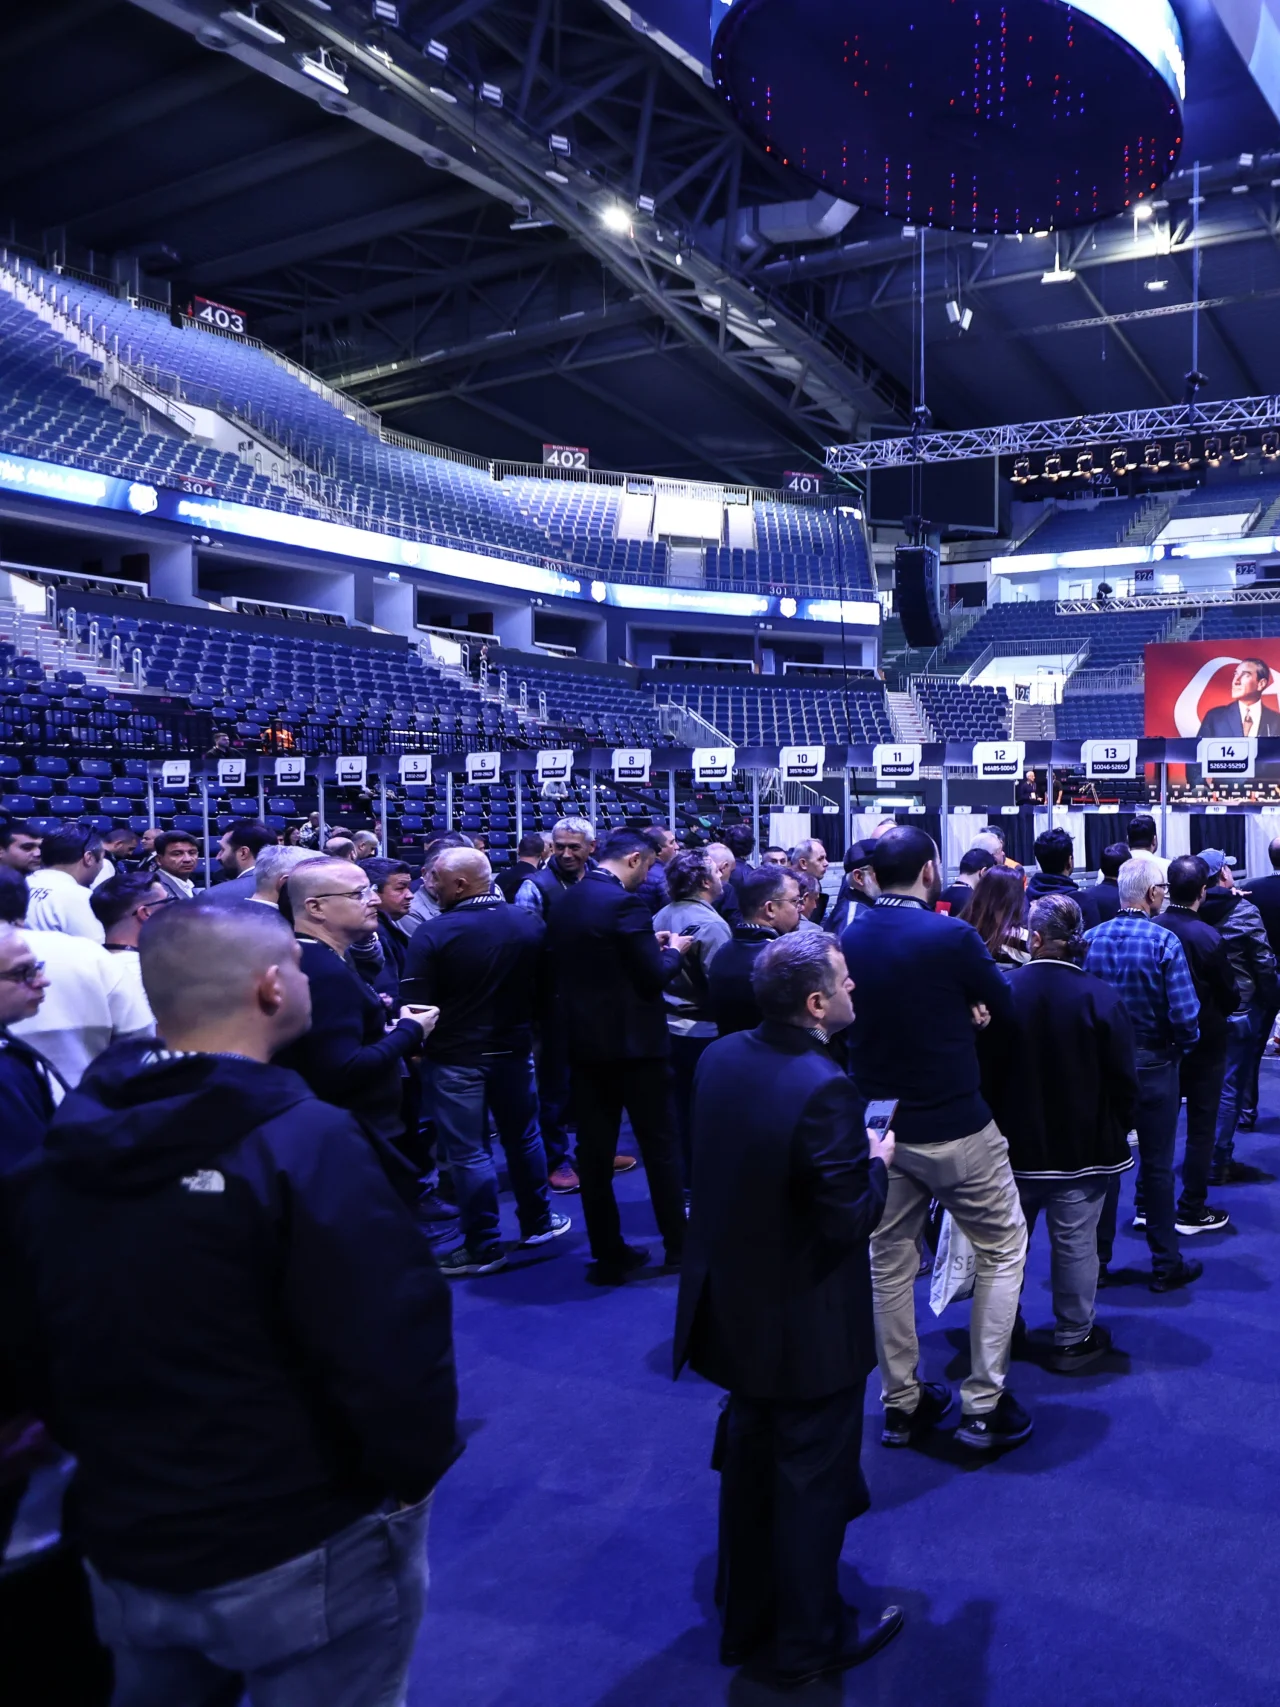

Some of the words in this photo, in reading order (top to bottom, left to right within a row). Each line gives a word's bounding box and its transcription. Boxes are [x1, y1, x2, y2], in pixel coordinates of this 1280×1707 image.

[200, 306, 244, 333] 403
[547, 450, 586, 469] 402
[1088, 474, 1111, 485] 426
[182, 481, 214, 497] 304
[788, 476, 820, 494] 401
[1236, 565, 1256, 575] 325
[1136, 572, 1153, 581] 326
[769, 586, 788, 596] 301
[1016, 687, 1031, 702] 125
[994, 750, 1006, 760] 12
[1104, 748, 1117, 759] 13
[1220, 746, 1235, 757] 14
[552, 757, 557, 766] 7
[628, 756, 635, 765] 8
[710, 755, 717, 765] 9
[796, 754, 808, 764] 10
[893, 752, 902, 762] 11
[288, 763, 292, 772] 3
[349, 762, 354, 771] 4
[413, 761, 418, 770] 5
[480, 759, 486, 768] 6
